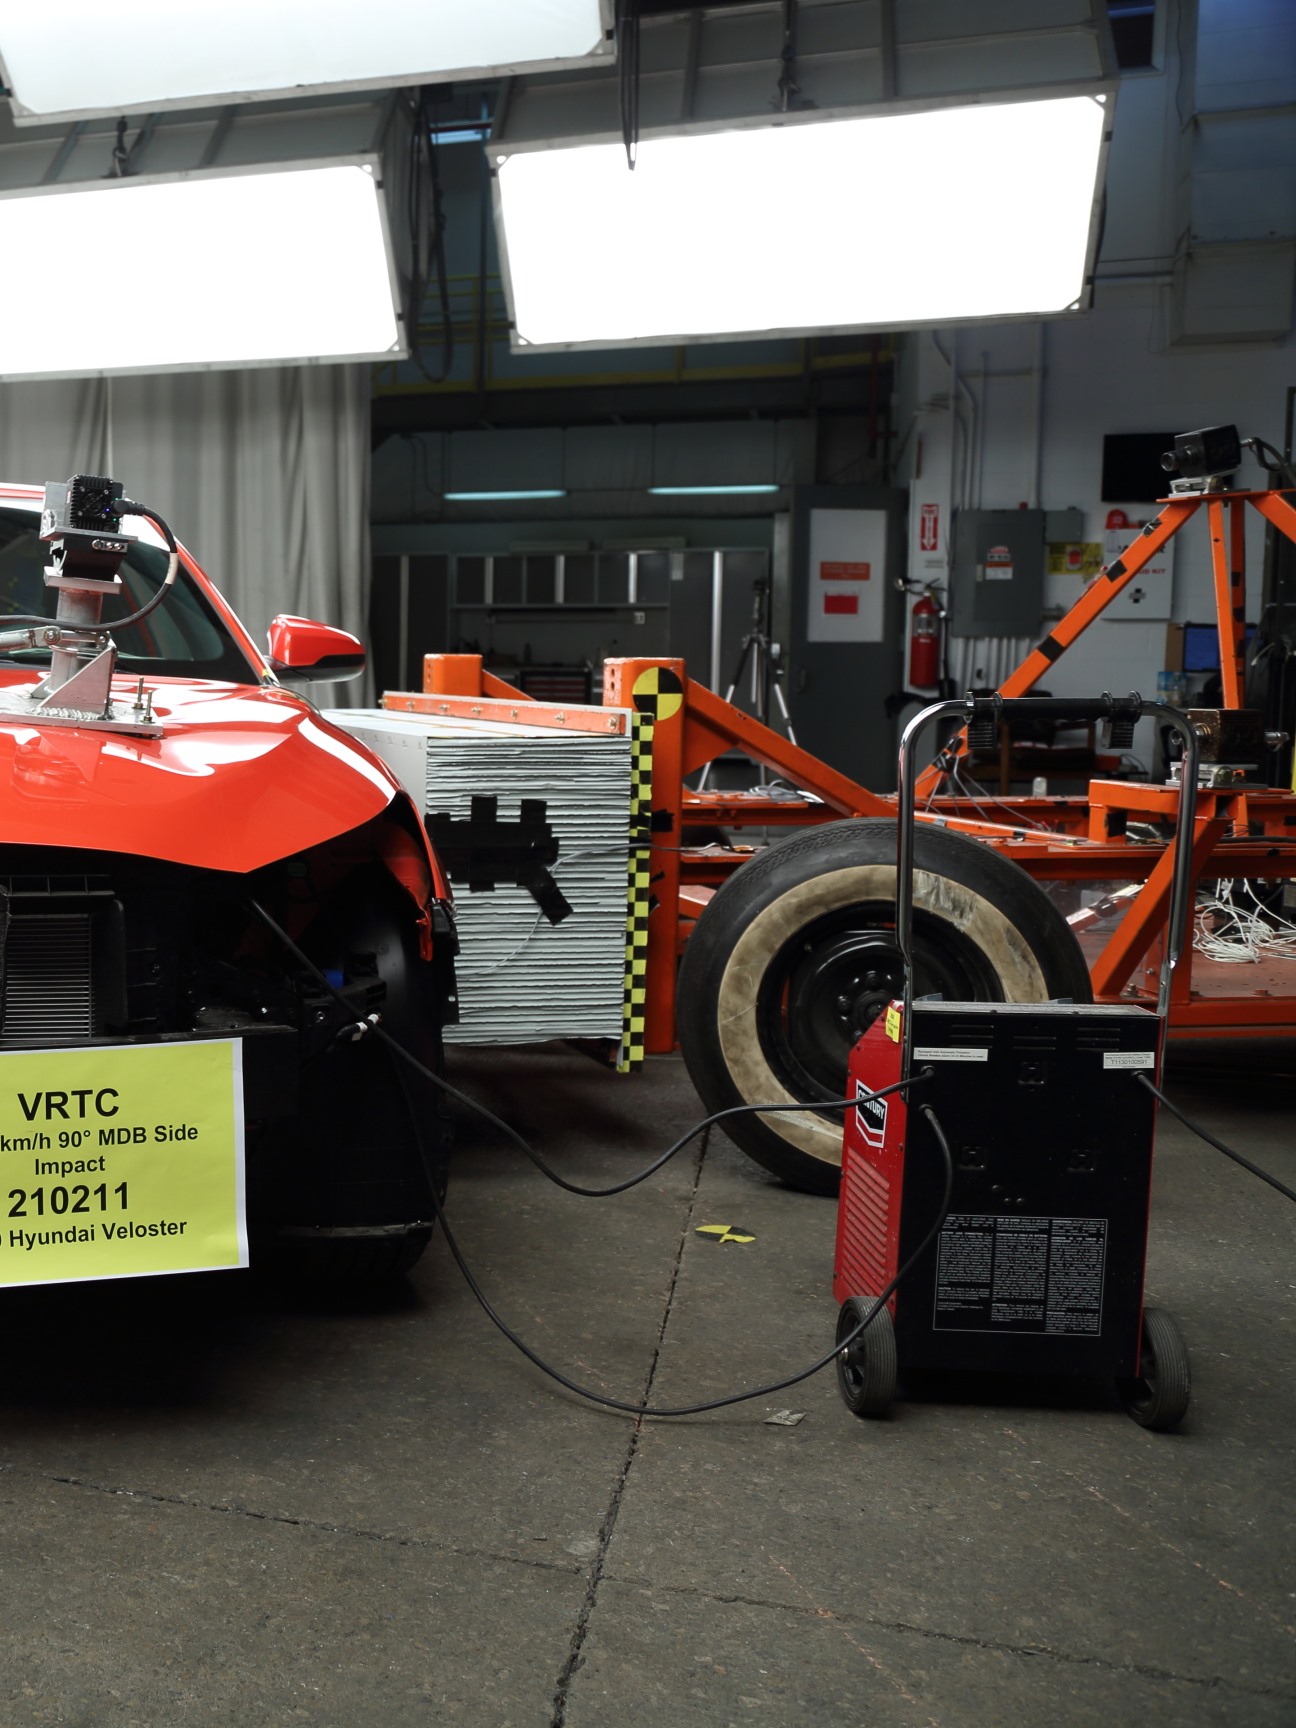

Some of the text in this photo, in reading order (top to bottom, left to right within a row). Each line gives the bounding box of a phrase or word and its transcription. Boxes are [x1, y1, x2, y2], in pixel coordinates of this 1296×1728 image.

[18, 1088, 120, 1121] VRTC
[1, 1133, 51, 1151] km/h
[59, 1130, 91, 1148] 90°
[99, 1127, 147, 1145] MDB
[155, 1124, 199, 1142] Side
[36, 1156, 106, 1178] Impact
[9, 1182, 128, 1217] 210211
[10, 1225, 95, 1250] Hyundai
[102, 1220, 187, 1240] Veloster
